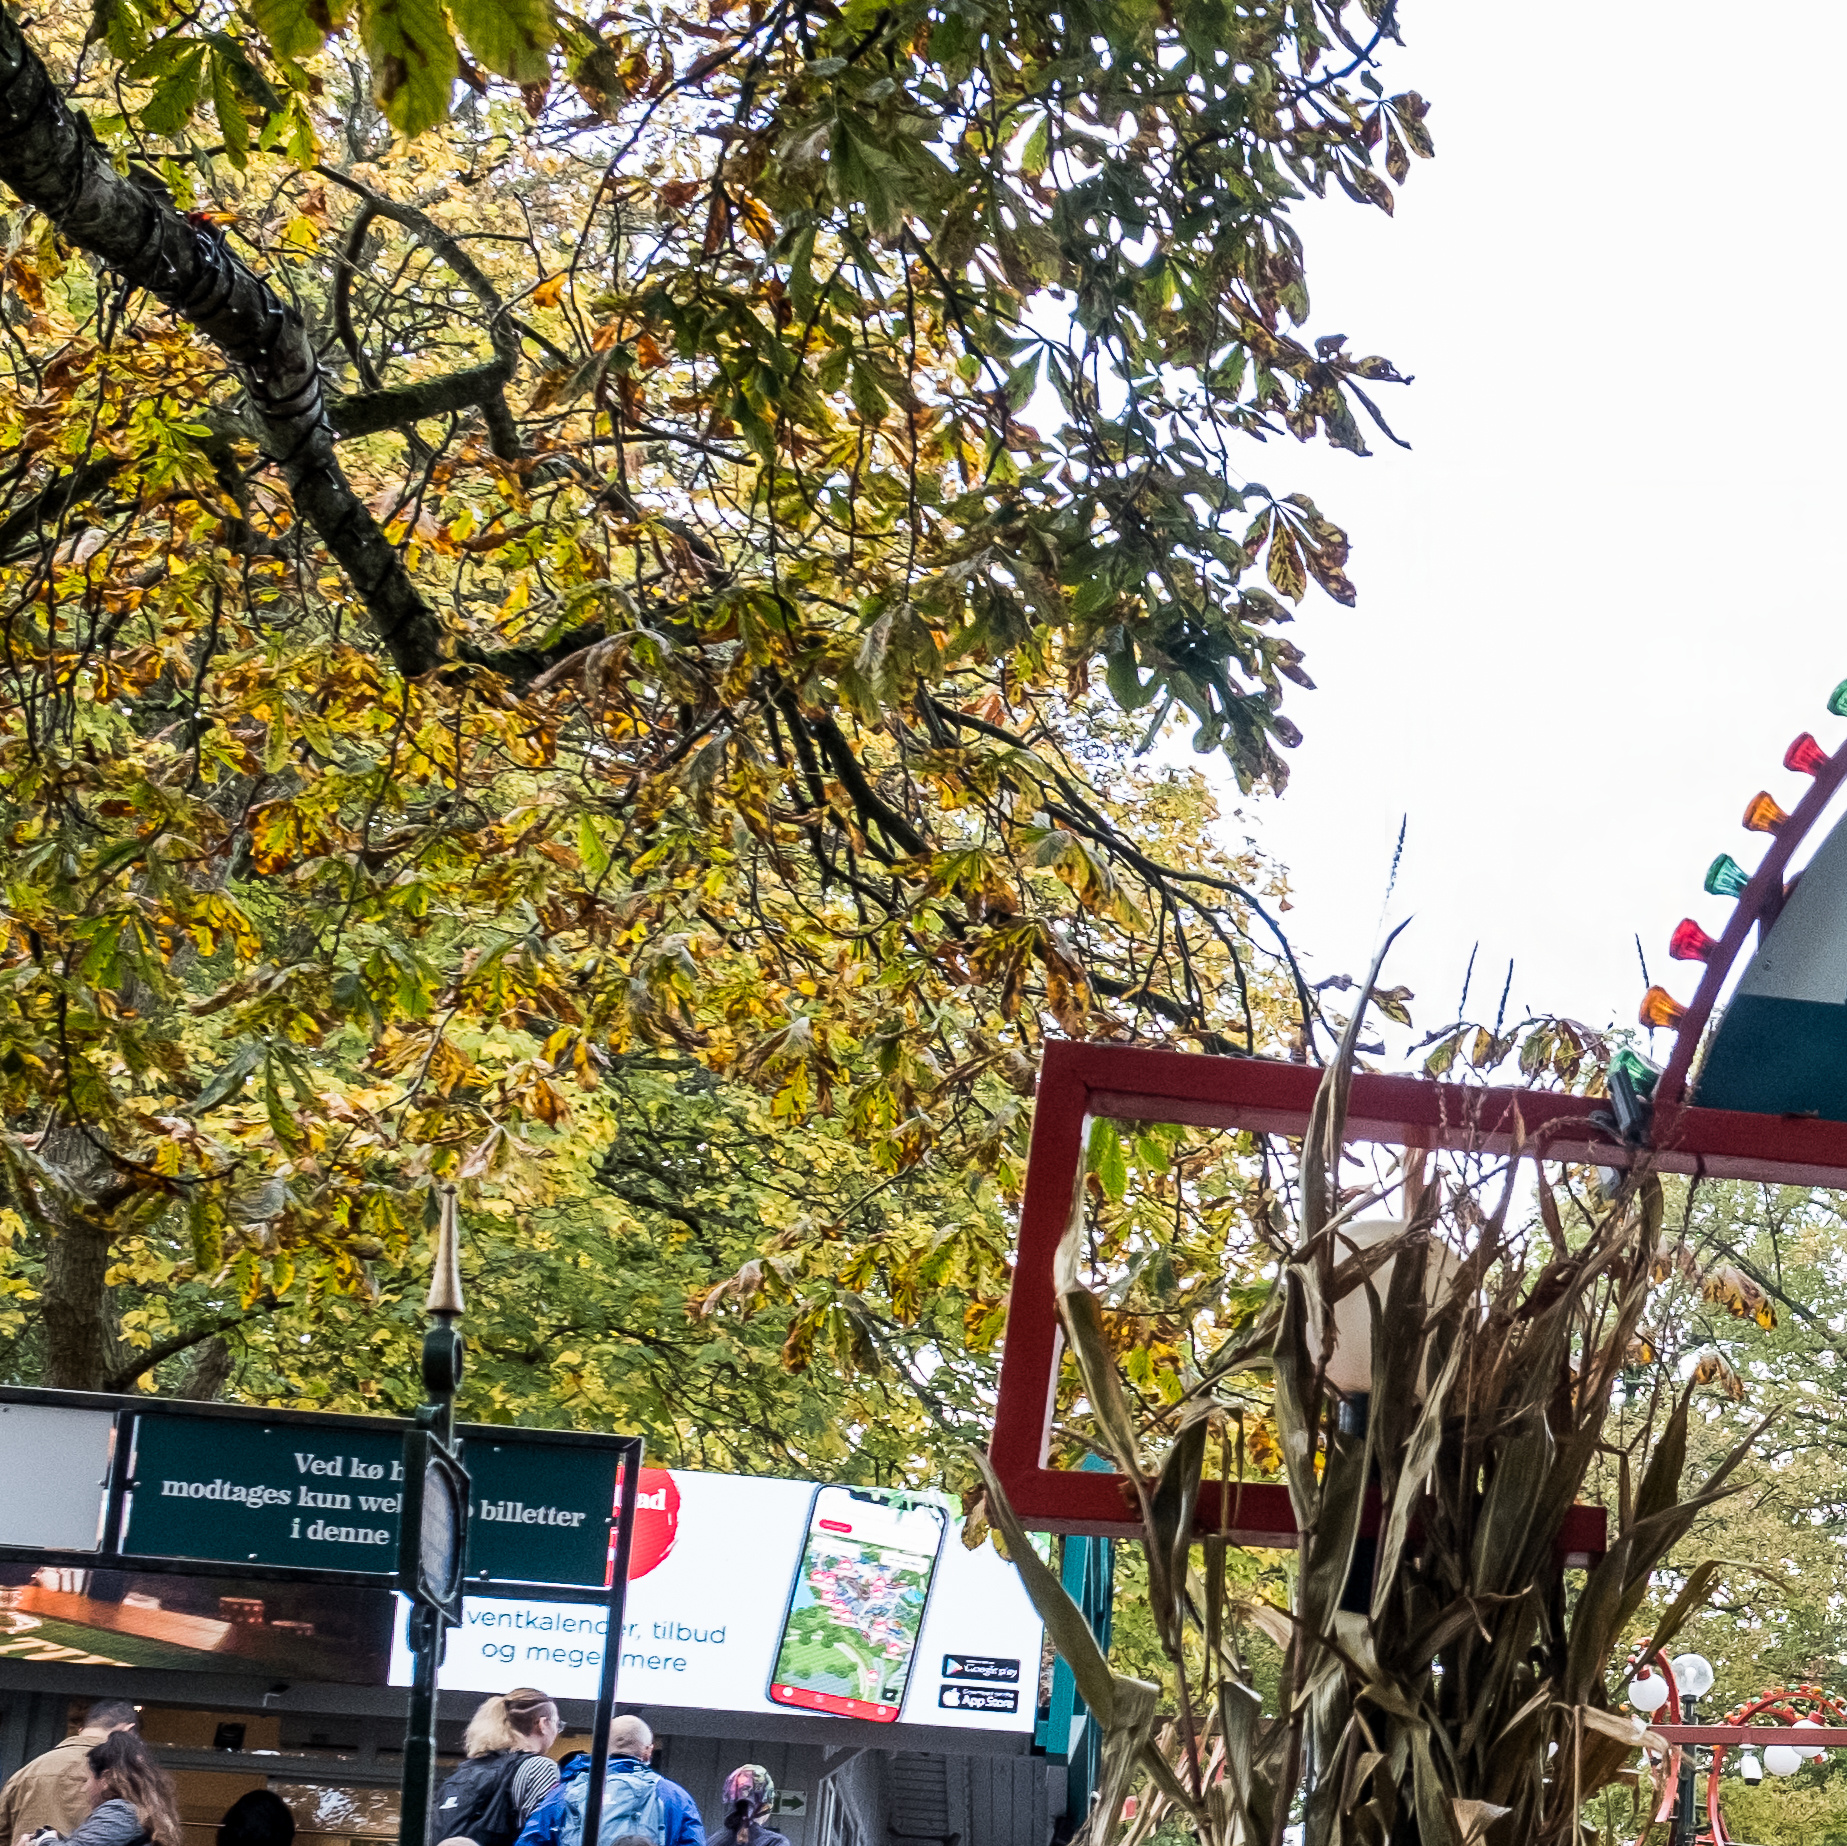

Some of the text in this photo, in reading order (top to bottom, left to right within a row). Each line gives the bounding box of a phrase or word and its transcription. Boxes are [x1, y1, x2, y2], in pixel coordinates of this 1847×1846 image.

[294, 1453, 345, 1479] Ved
[350, 1457, 384, 1481] kø
[161, 1477, 292, 1510] modtages
[299, 1487, 352, 1512] kun
[480, 1499, 586, 1529] billetter
[290, 1518, 301, 1540] i
[306, 1521, 390, 1546] denne
[652, 1620, 727, 1645] tilbud
[481, 1642, 688, 1673] og mege mere
[961, 1694, 1015, 1710] App Store
